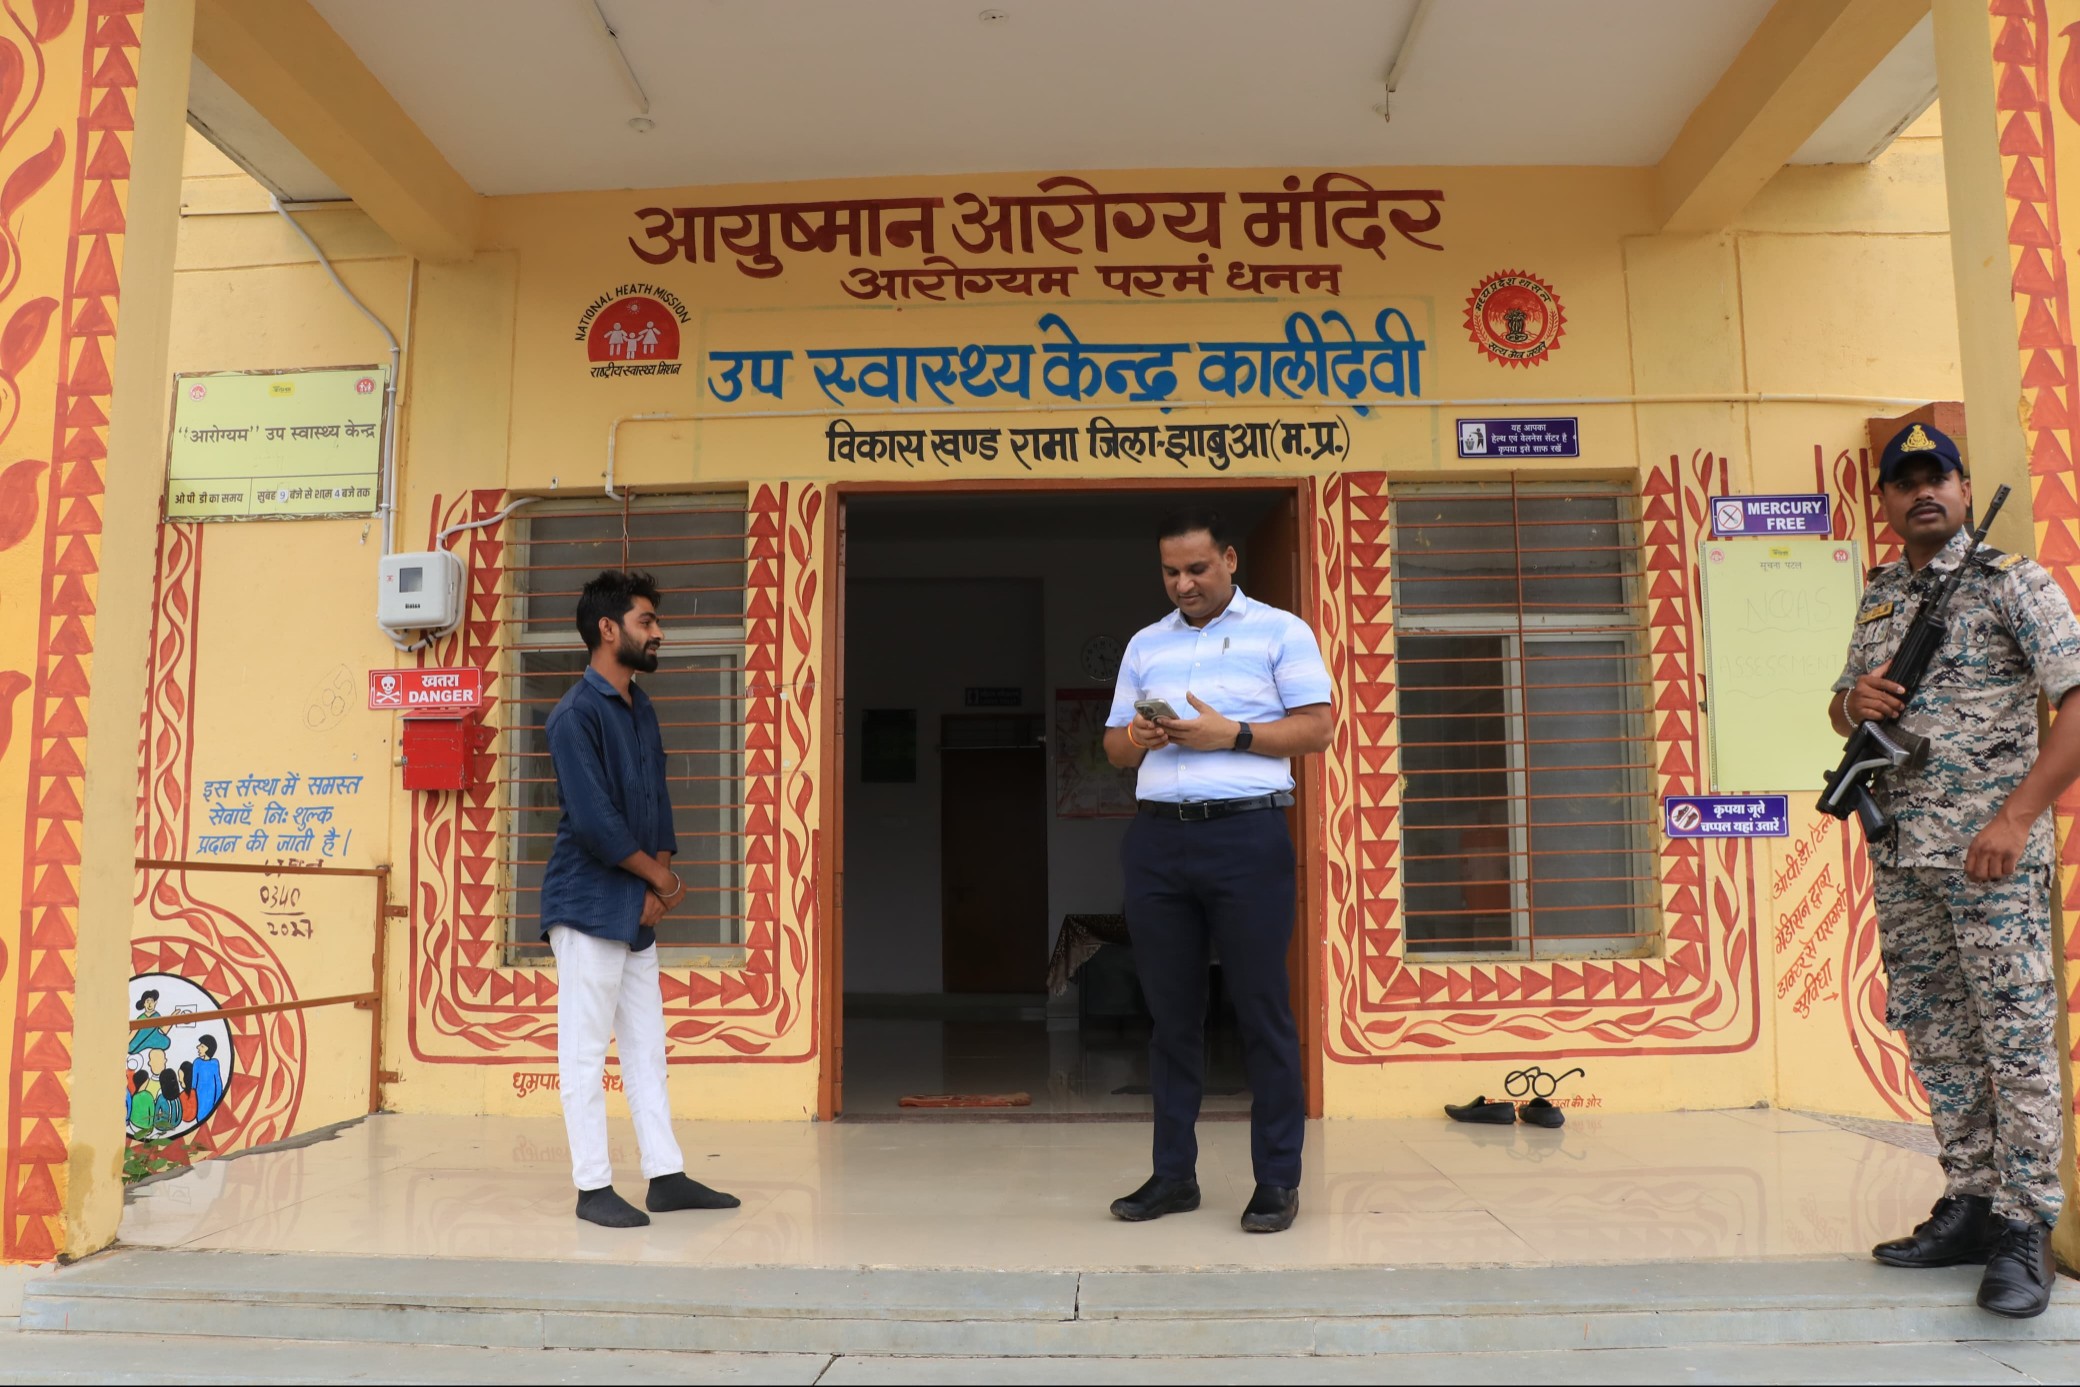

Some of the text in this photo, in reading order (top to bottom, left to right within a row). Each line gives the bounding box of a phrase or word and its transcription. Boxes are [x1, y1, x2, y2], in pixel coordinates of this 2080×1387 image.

[628, 173, 1446, 279] आयुष्मान आरोग्य मंदिर
[840, 256, 1079, 301] आरोग्यम
[1095, 253, 1214, 297] परमं
[575, 283, 692, 341] NATIONAL HEATH MISSION
[656, 361, 682, 376] मिशन
[708, 307, 1426, 418] उप स्वास्थ्य केन्द्र कालीदेवी
[265, 427, 286, 441] उप
[290, 424, 341, 442] स्वास्थ्य
[344, 419, 377, 439] केन्द्र
[1524, 424, 1547, 432] आपका
[825, 419, 927, 468] विकास
[931, 428, 1001, 468] खण्ड
[1009, 427, 1079, 471] रामा
[1491, 433, 1506, 444] हेल्थ
[1520, 433, 1542, 443] वेलनेस
[1562, 432, 1568, 443] है
[174, 491, 244, 505] ओ पी डी का समय
[279, 490, 287, 500] 9
[304, 487, 314, 500] से
[334, 487, 341, 498] 4
[341, 485, 355, 498] बजे
[356, 487, 371, 498] तक
[1747, 501, 1822, 515] MERCURY
[1767, 517, 1806, 531] FREE
[1784, 561, 1802, 570] पटल
[421, 674, 460, 688] खतरा
[408, 689, 474, 703] DANGER
[203, 771, 364, 802] इस संस्था में समस्त
[208, 802, 254, 826] सेवाएँ
[1713, 800, 1766, 819] कृपया जूते
[1700, 817, 1780, 834] चप्पल यहां उतारें
[196, 835, 243, 856] प्रदान
[246, 828, 269, 852] की
[276, 827, 315, 853] जाती
[513, 1071, 560, 1098] धुम्रपा
